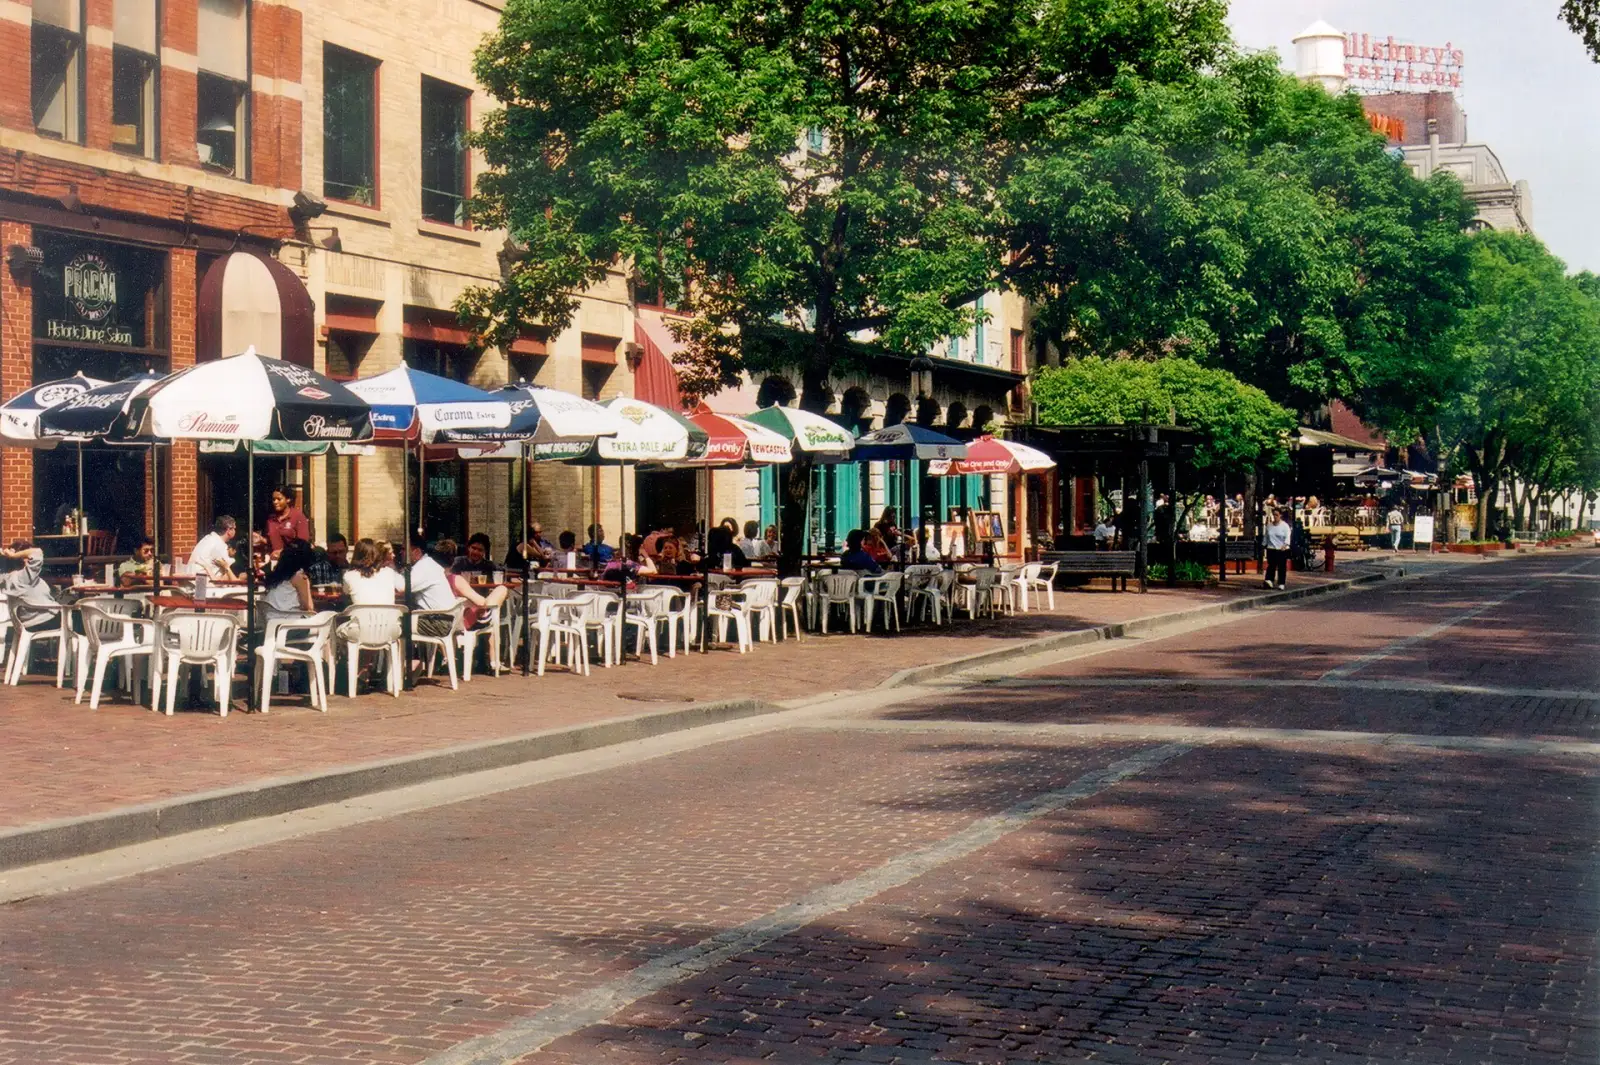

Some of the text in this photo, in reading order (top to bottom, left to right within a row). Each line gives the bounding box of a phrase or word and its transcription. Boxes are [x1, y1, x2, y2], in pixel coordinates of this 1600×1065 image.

[1342, 32, 1464, 72] illsbury's
[1343, 63, 1383, 81] EST
[64, 265, 117, 304] PRACNA
[47, 320, 132, 346] Historic Dining Saloon
[178, 411, 240, 434] Premium
[372, 412, 396, 422] Extra
[434, 408, 496, 422] Corona Extra
[303, 414, 353, 438] Premium
[611, 441, 638, 453] EXTRA
[641, 441, 660, 453] PALE
[662, 441, 677, 453] ALE
[721, 442, 742, 456] Only
[751, 443, 788, 456] NEWCASTLE
[995, 460, 1010, 469] Only
